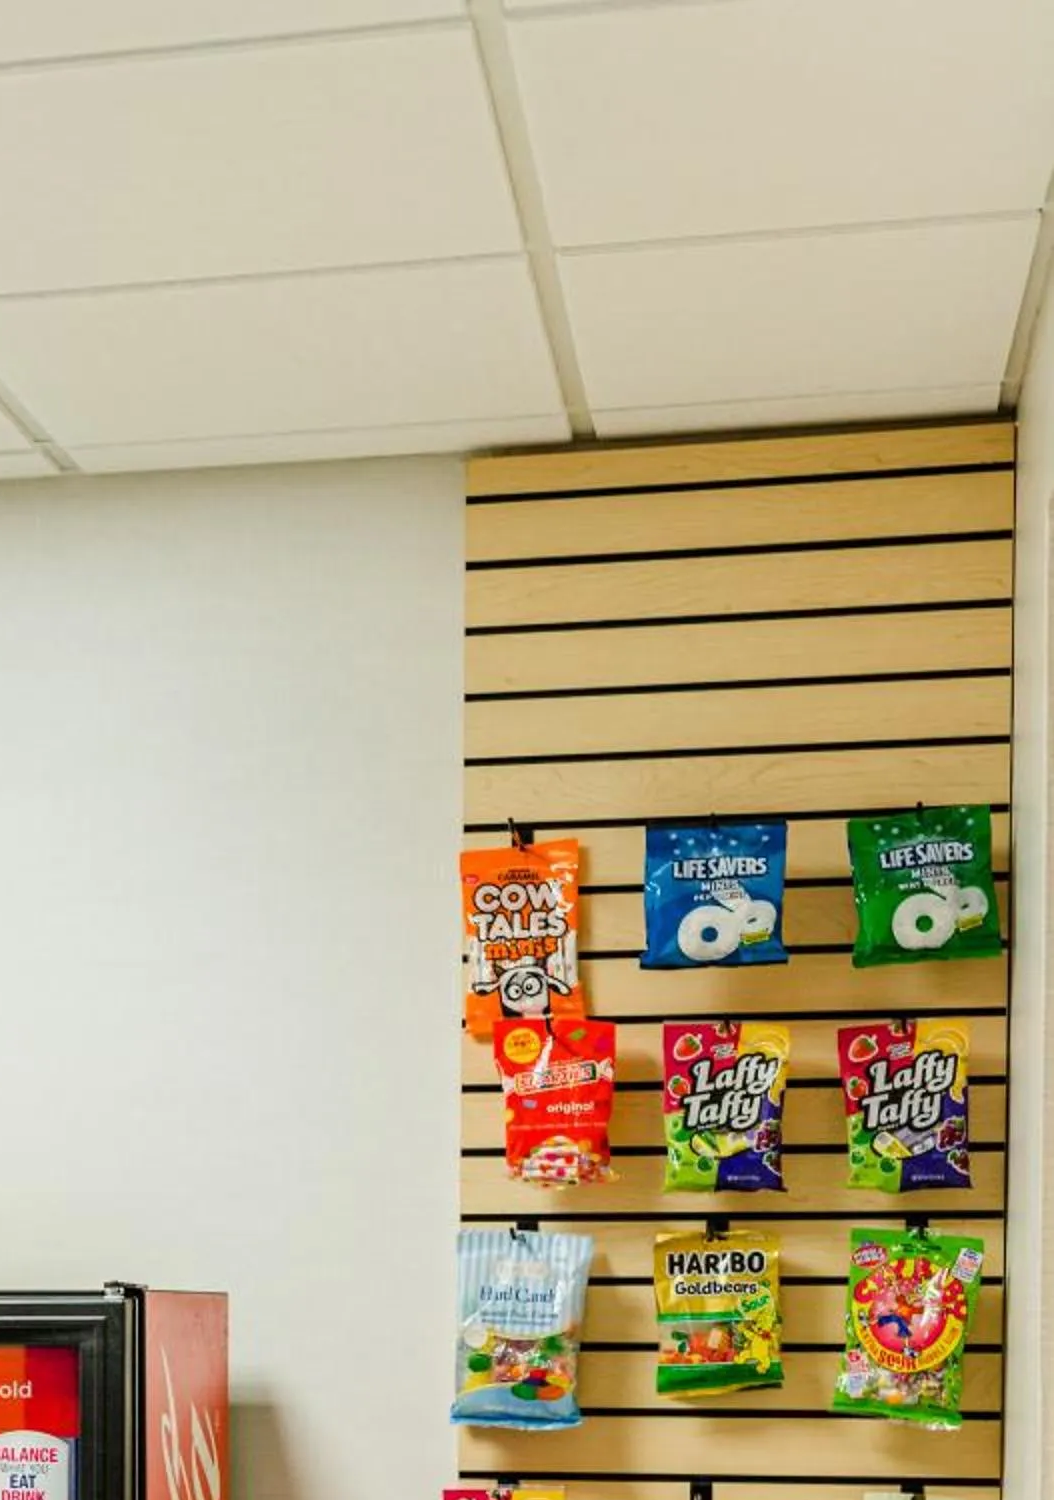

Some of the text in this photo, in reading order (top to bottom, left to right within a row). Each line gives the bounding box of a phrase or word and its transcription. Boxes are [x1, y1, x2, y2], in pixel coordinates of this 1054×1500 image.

[673, 857, 767, 879] LIFE SAVERS
[880, 841, 974, 868] LIFE SAVERS
[473, 882, 560, 913] COW
[472, 912, 568, 941] TALES
[484, 937, 558, 961] minis
[692, 1055, 779, 1094] Laffy
[870, 1051, 956, 1093] Laffy
[546, 1102, 595, 1115] original
[684, 1091, 761, 1129] Taffy
[861, 1089, 941, 1129] Taffy
[668, 1251, 766, 1275] HARIBO
[674, 1281, 757, 1296] Goldbears
[9, 1473, 36, 1489] EAT
